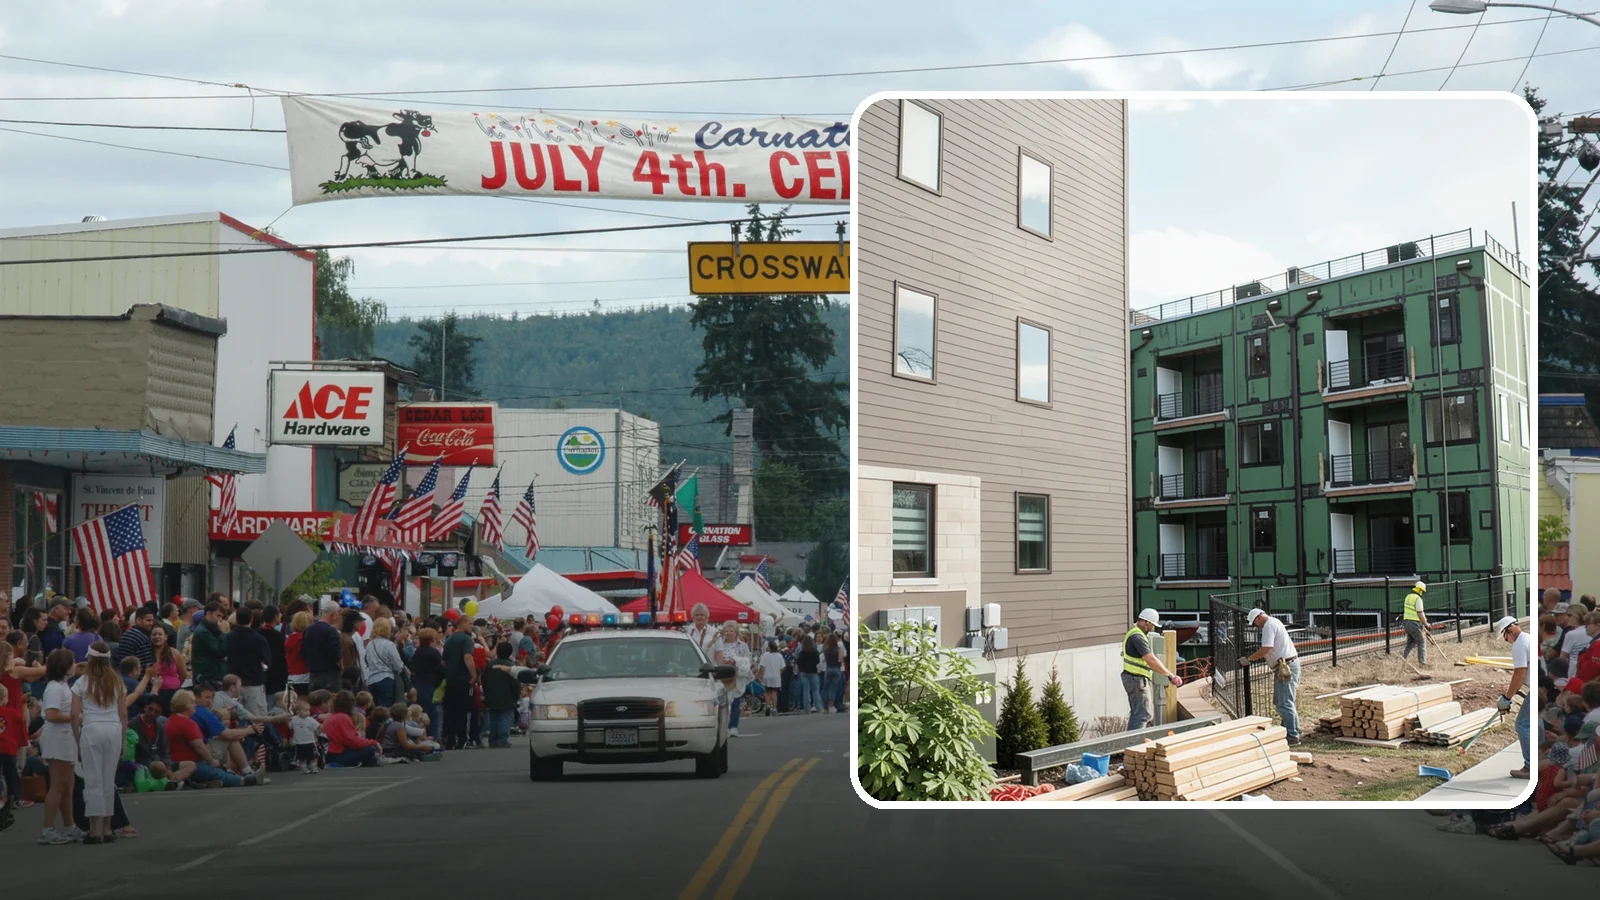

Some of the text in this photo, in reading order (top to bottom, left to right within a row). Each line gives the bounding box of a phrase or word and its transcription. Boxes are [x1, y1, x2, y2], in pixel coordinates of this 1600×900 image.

[695, 121, 850, 150] Carnat
[481, 141, 605, 192] JULY
[632, 151, 746, 197] 4th.
[697, 254, 850, 280] CROSSWA
[283, 380, 373, 420] ACE
[406, 409, 485, 422] CEDAR LOG
[283, 421, 370, 436] Hardware
[416, 428, 476, 446] Coca-Cola
[353, 467, 385, 480] Simpl
[83, 485, 155, 495] St. Vincent de Paul
[212, 516, 330, 535] HARDARE
[688, 527, 742, 535] CRNATION
[699, 535, 730, 543] GLASS
